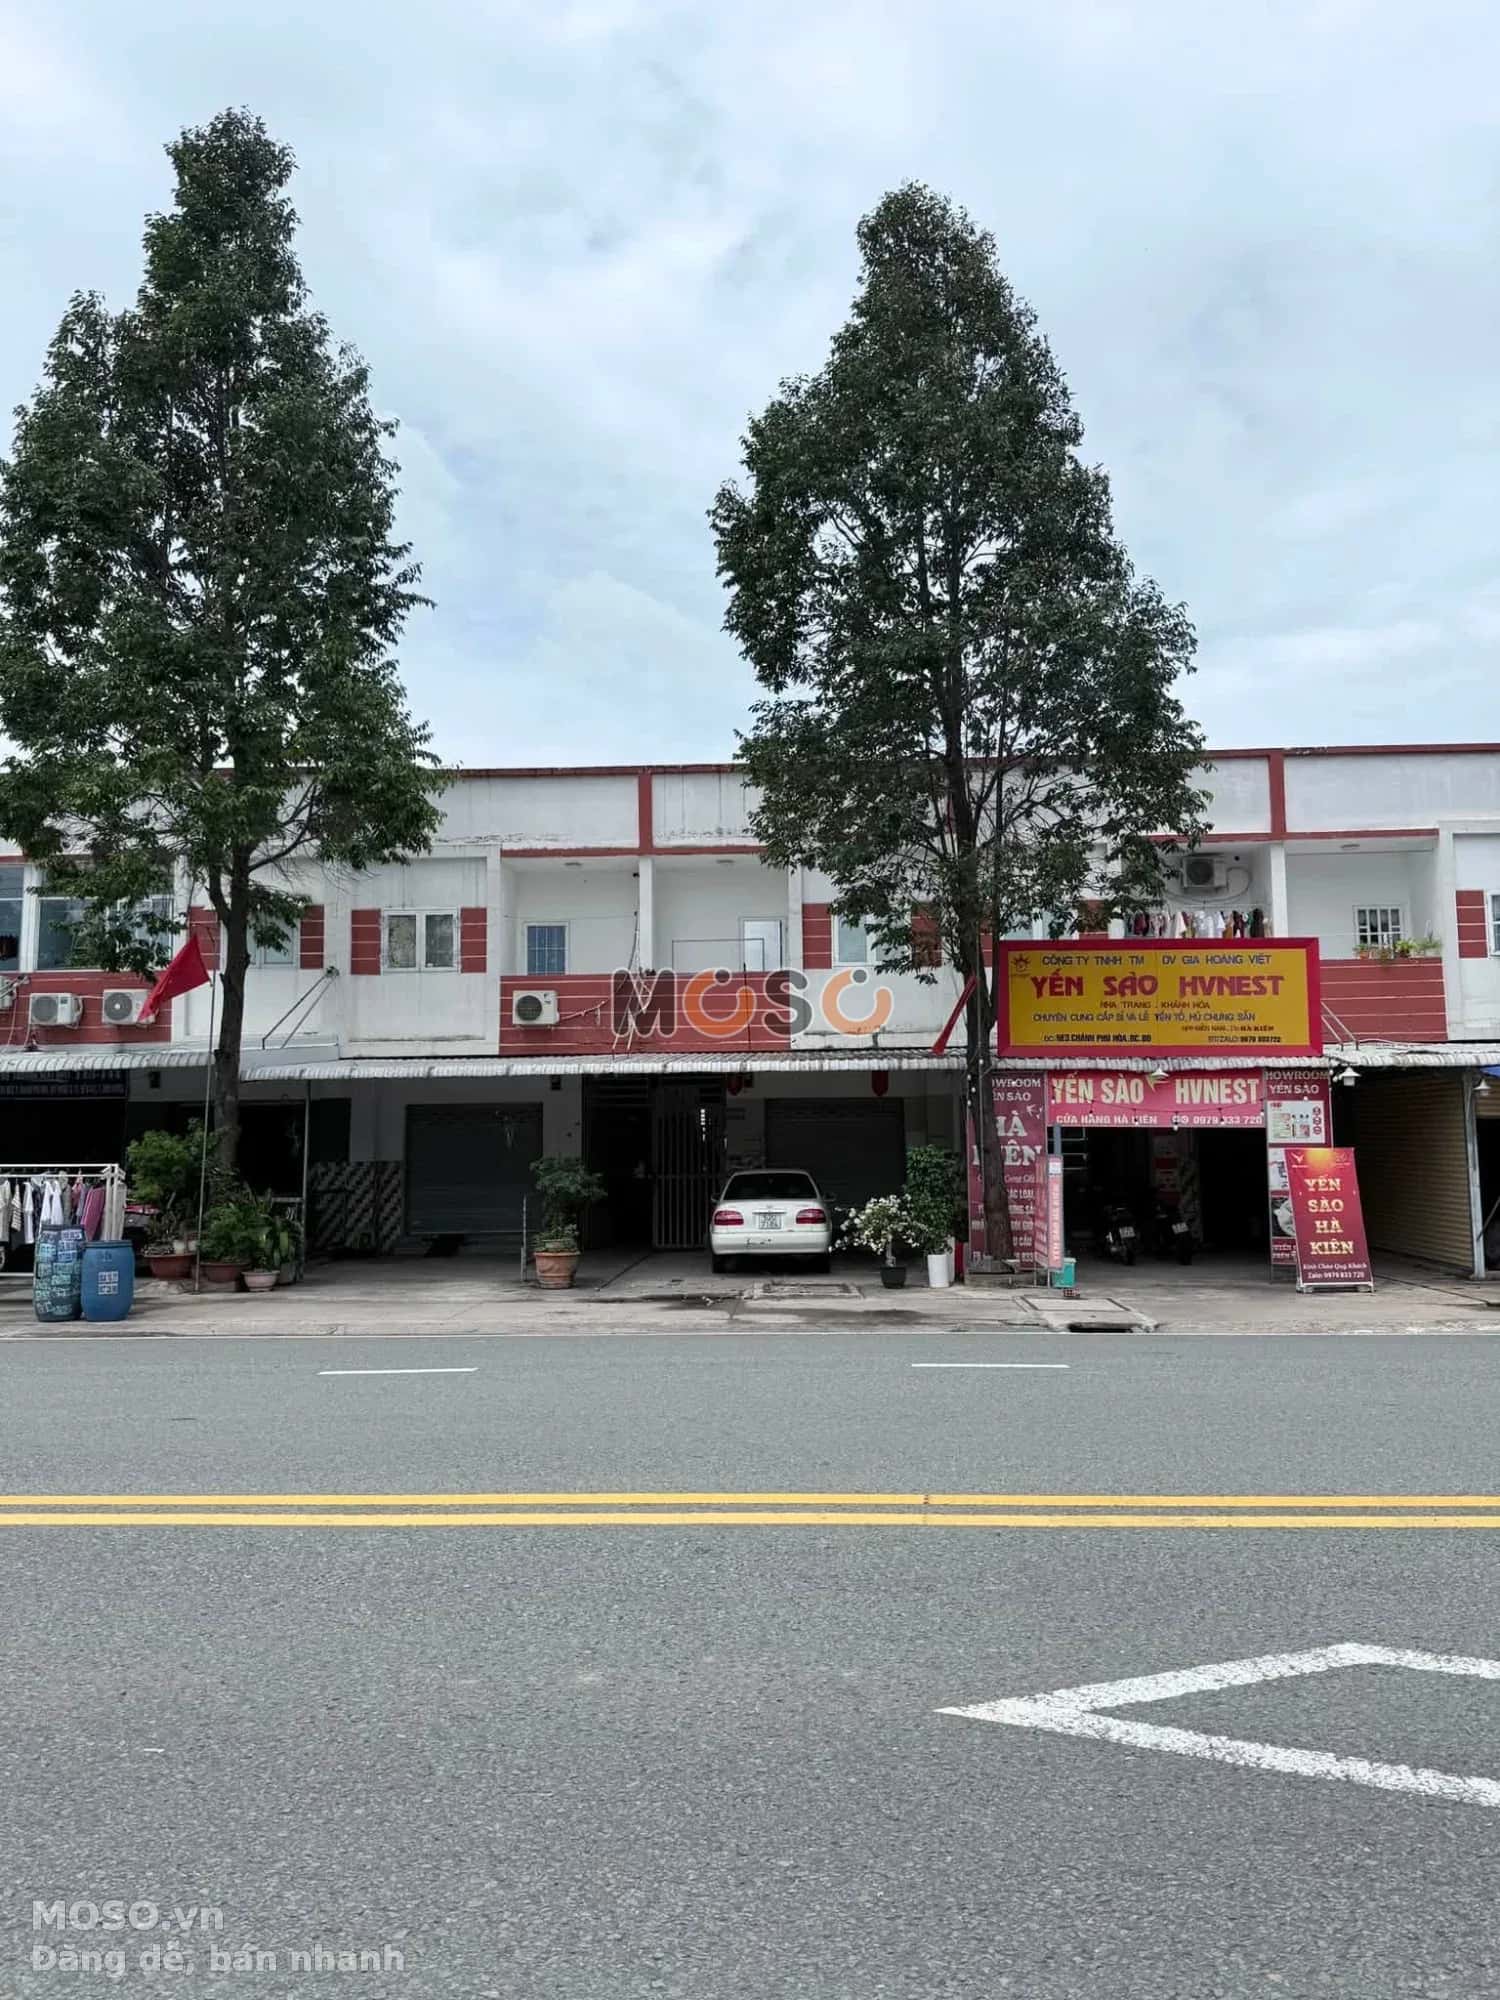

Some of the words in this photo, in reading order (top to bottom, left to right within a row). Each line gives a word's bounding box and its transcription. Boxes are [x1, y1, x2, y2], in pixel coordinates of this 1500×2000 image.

[1042, 953, 1074, 966] CÔNG
[1076, 955, 1090, 965] TY
[1095, 955, 1122, 965] TNHH
[1128, 955, 1145, 965] TM
[1182, 955, 1200, 964] GIA
[1031, 968, 1084, 999] YẾN
[1179, 975, 1284, 998] HVNEST
[1100, 1001, 1117, 1009] NHA
[1122, 1001, 1151, 1009] TRANG
[1161, 999, 1190, 1009] KHÁNH
[1070, 1012, 1094, 1021] CUNG
[1265, 1070, 1328, 1081] HOWROOM
[1052, 1072, 1095, 1104] YẾN
[1101, 1073, 1144, 1104] SÀO
[1175, 1078, 1260, 1104] HVNEST
[1056, 1112, 1078, 1124] CỬA
[1081, 1112, 1111, 1124] HÀNG
[1114, 1113, 1129, 1124] HÀ
[1193, 1115, 1218, 1125] 0979
[1304, 1174, 1341, 1191] YẾN
[1307, 1196, 1344, 1212] SÀO
[1315, 1217, 1343, 1233] HÀ
[1309, 1238, 1354, 1254] KIÊN
